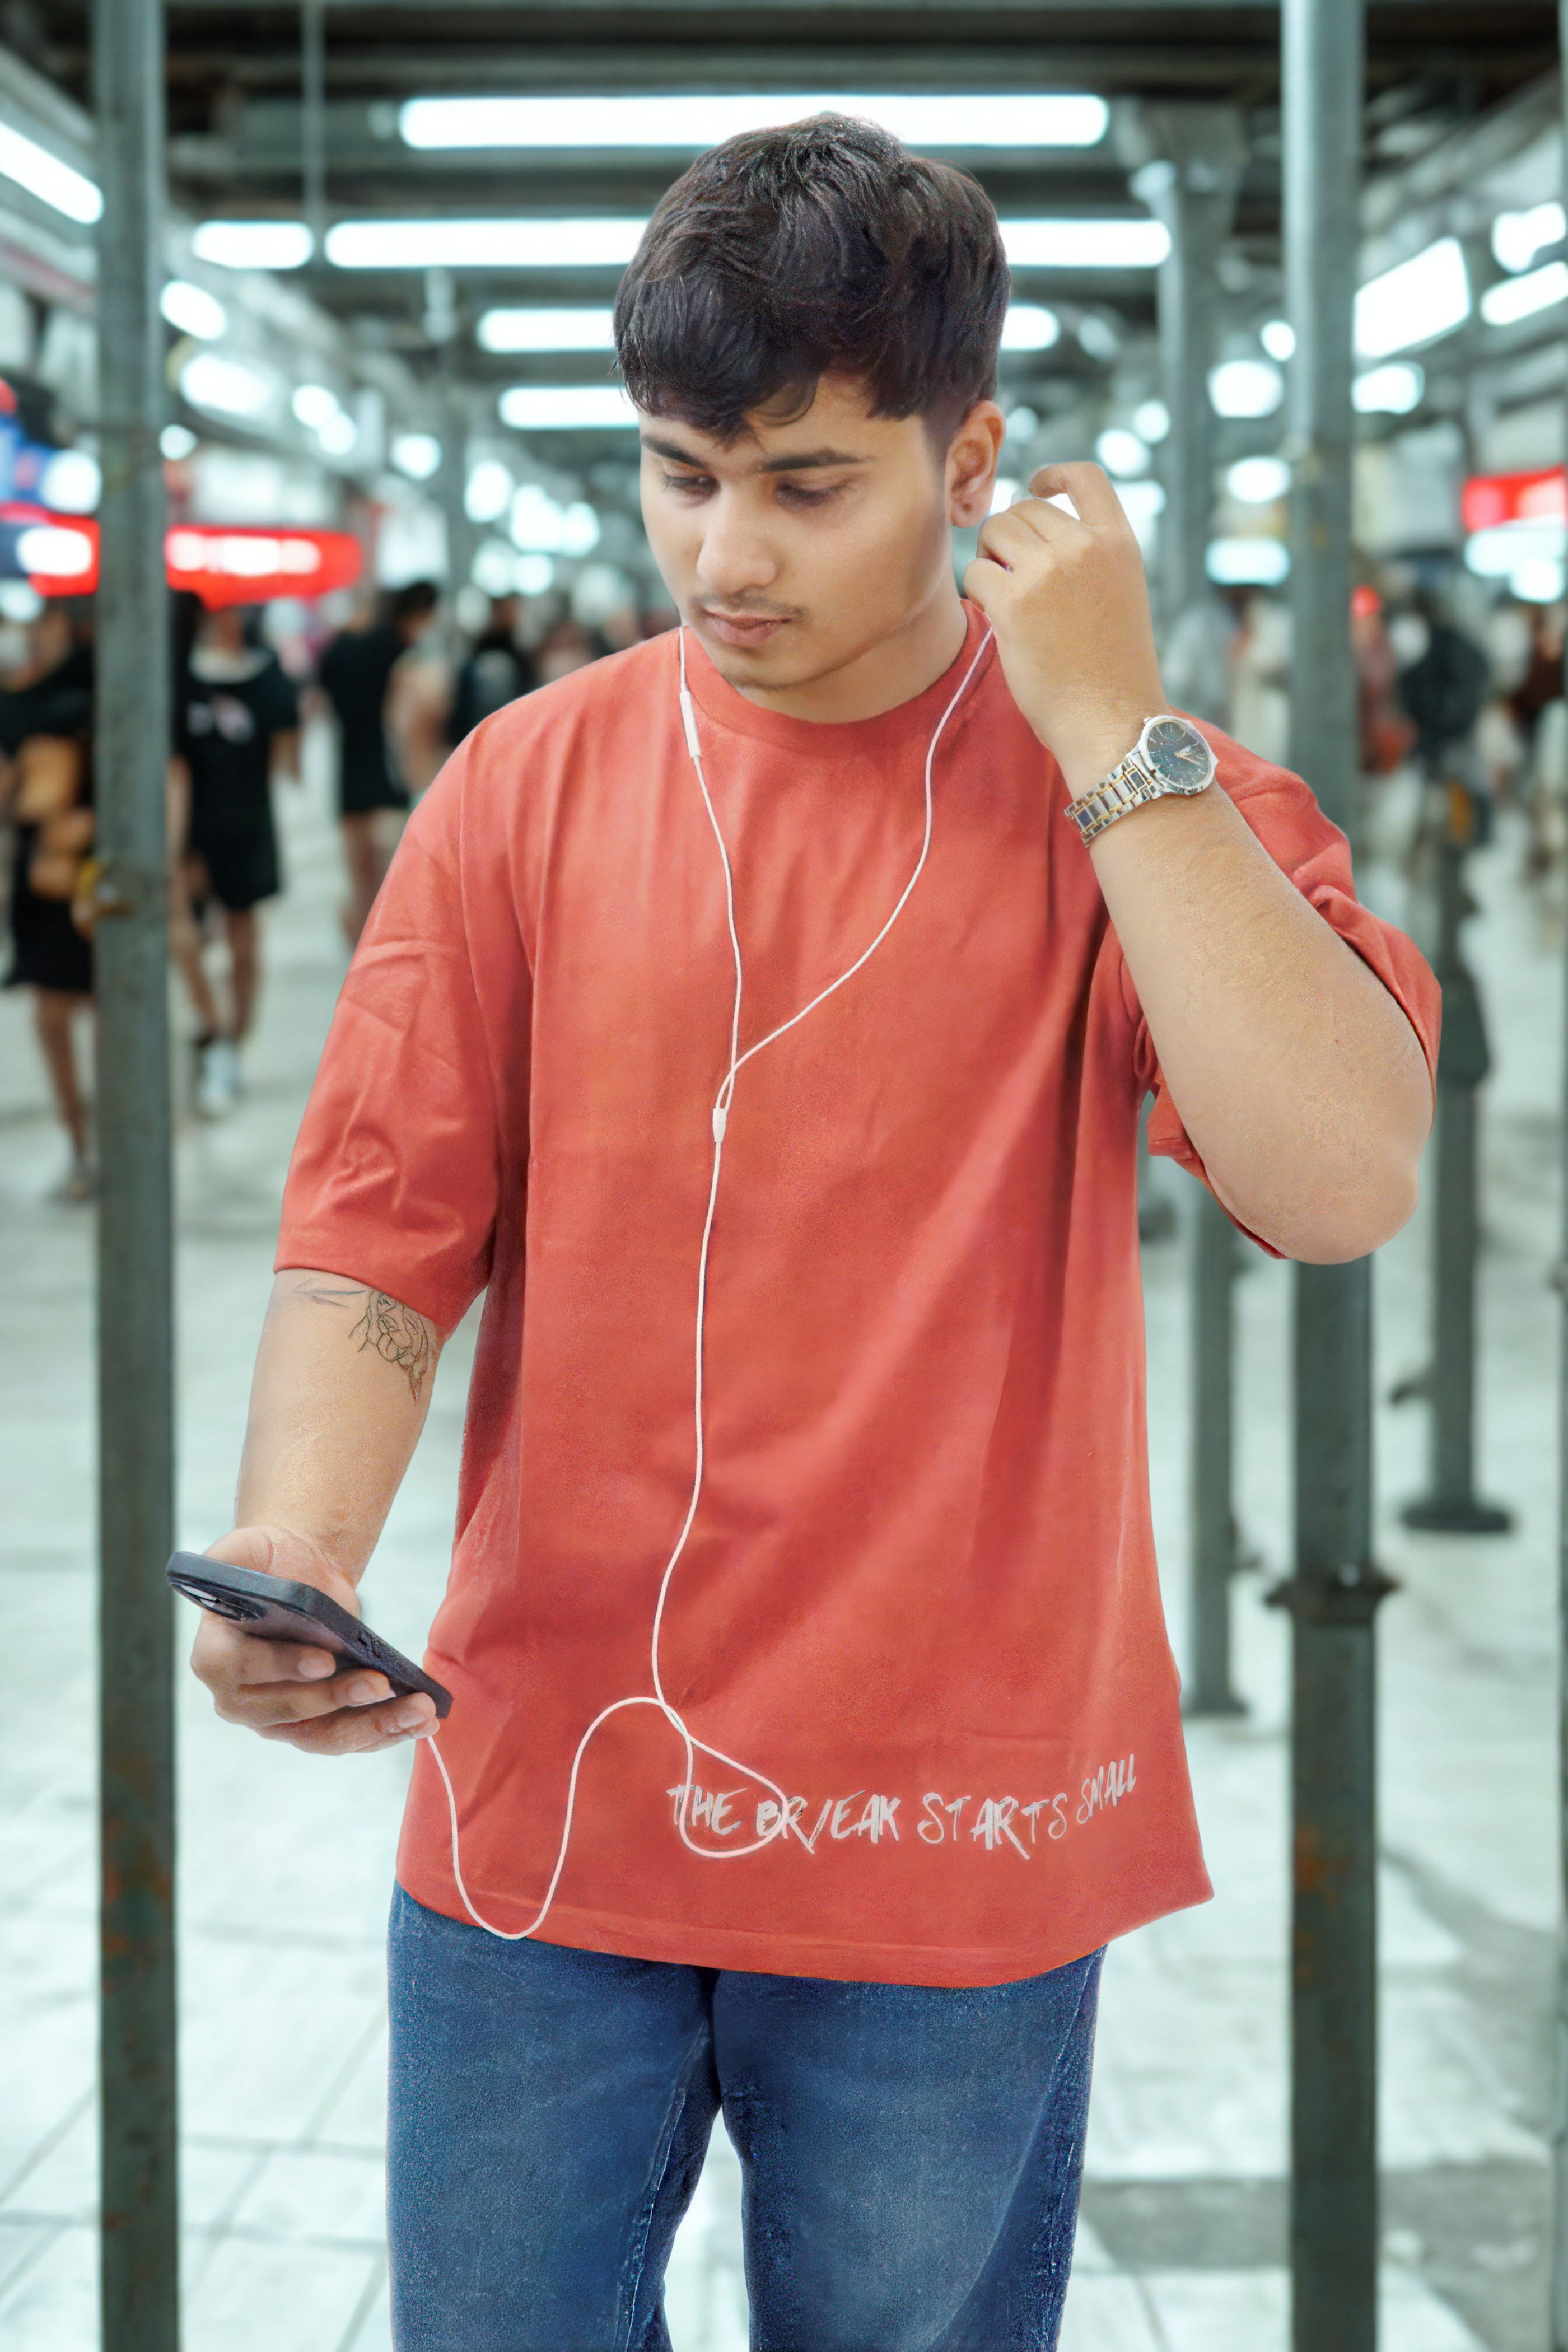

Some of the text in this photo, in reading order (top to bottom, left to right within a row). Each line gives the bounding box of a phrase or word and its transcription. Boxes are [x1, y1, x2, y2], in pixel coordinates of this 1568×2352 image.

[666, 1785, 748, 1835] THE
[917, 1792, 1068, 1860] STARTS
[1076, 1754, 1137, 1824] SMALL
